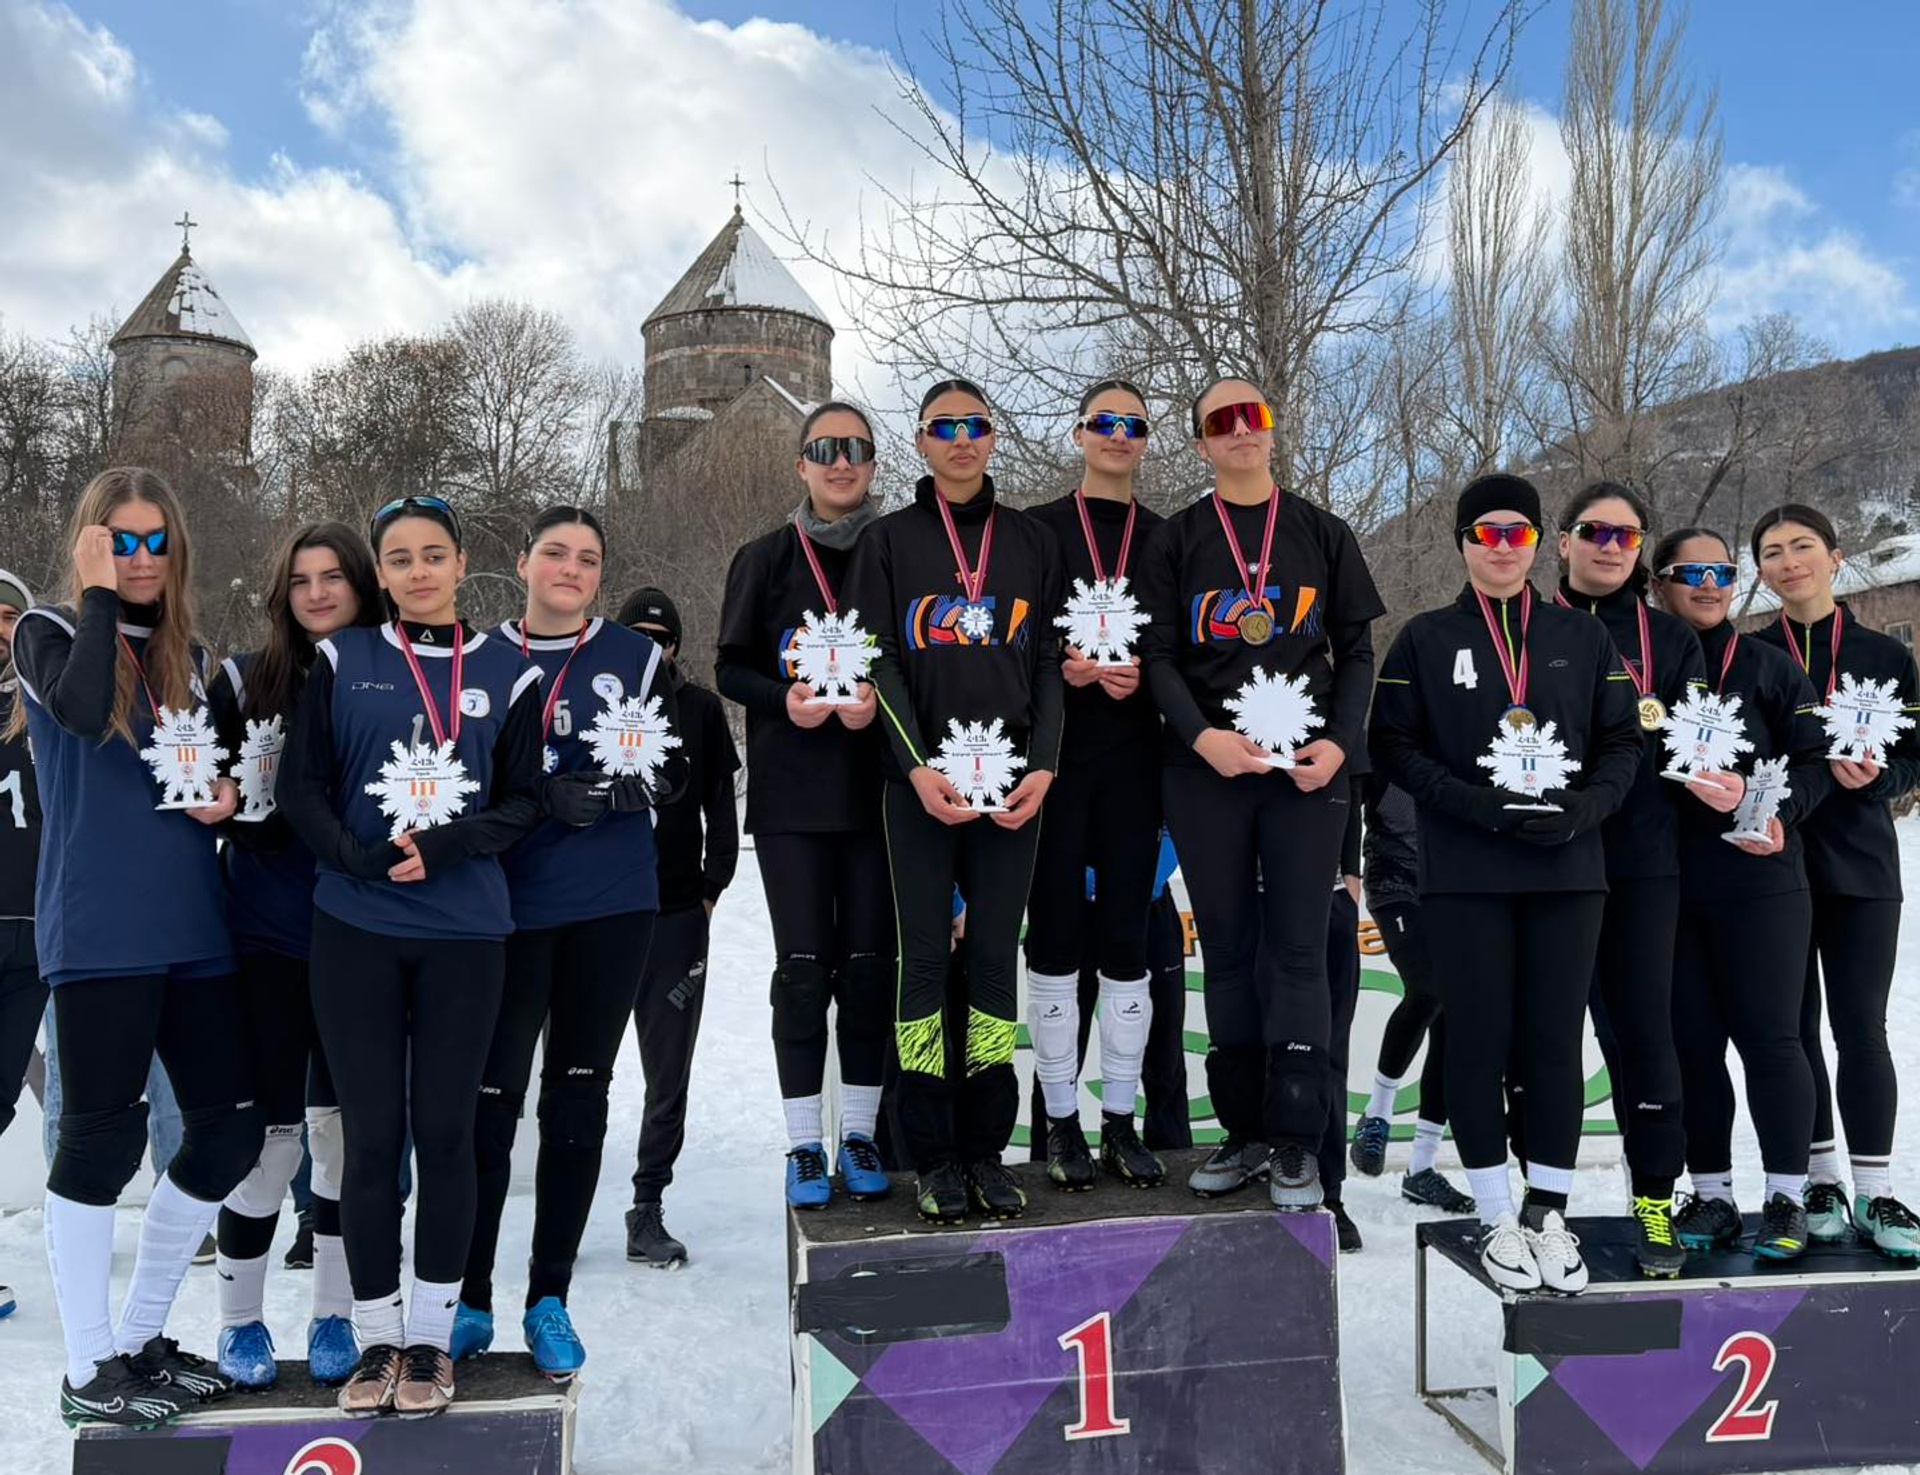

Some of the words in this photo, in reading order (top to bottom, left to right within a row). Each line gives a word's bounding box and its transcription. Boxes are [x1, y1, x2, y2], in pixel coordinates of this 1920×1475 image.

[1453, 648, 1478, 689] 4
[553, 699, 572, 736] 5
[1856, 711, 1871, 724] II
[619, 732, 641, 747] III
[1697, 727, 1713, 743] II
[177, 747, 197, 762] III
[1522, 758, 1536, 771] II
[411, 781, 436, 796] III
[0, 769, 28, 829] 1
[1395, 915, 1405, 934] 1
[1056, 1311, 1131, 1442] 1
[1705, 1330, 1779, 1443] 2
